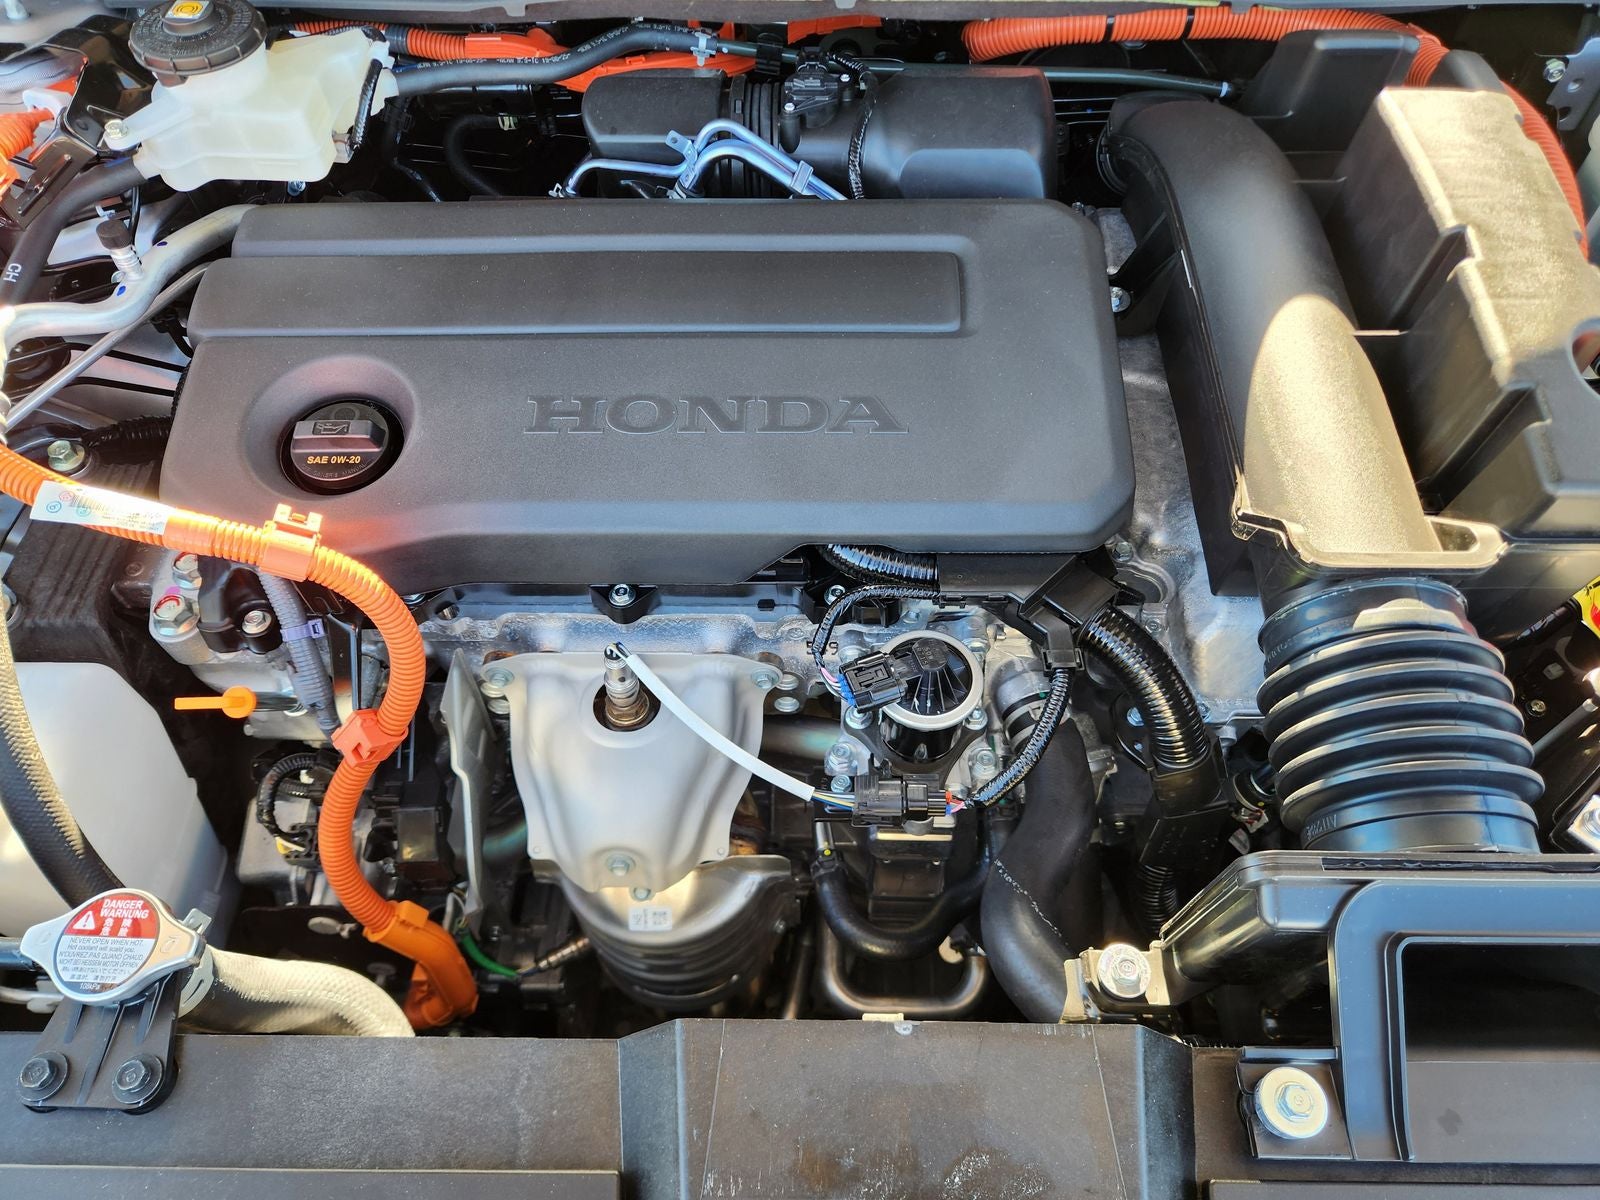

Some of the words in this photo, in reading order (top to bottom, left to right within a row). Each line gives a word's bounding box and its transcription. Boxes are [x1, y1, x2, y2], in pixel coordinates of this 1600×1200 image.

[3, 263, 21, 282] CH
[523, 396, 909, 435] HONDA
[307, 456, 328, 464] SAE
[330, 455, 361, 464] 0W-20
[102, 899, 144, 910] DANGER
[100, 908, 150, 919] WARNUNG
